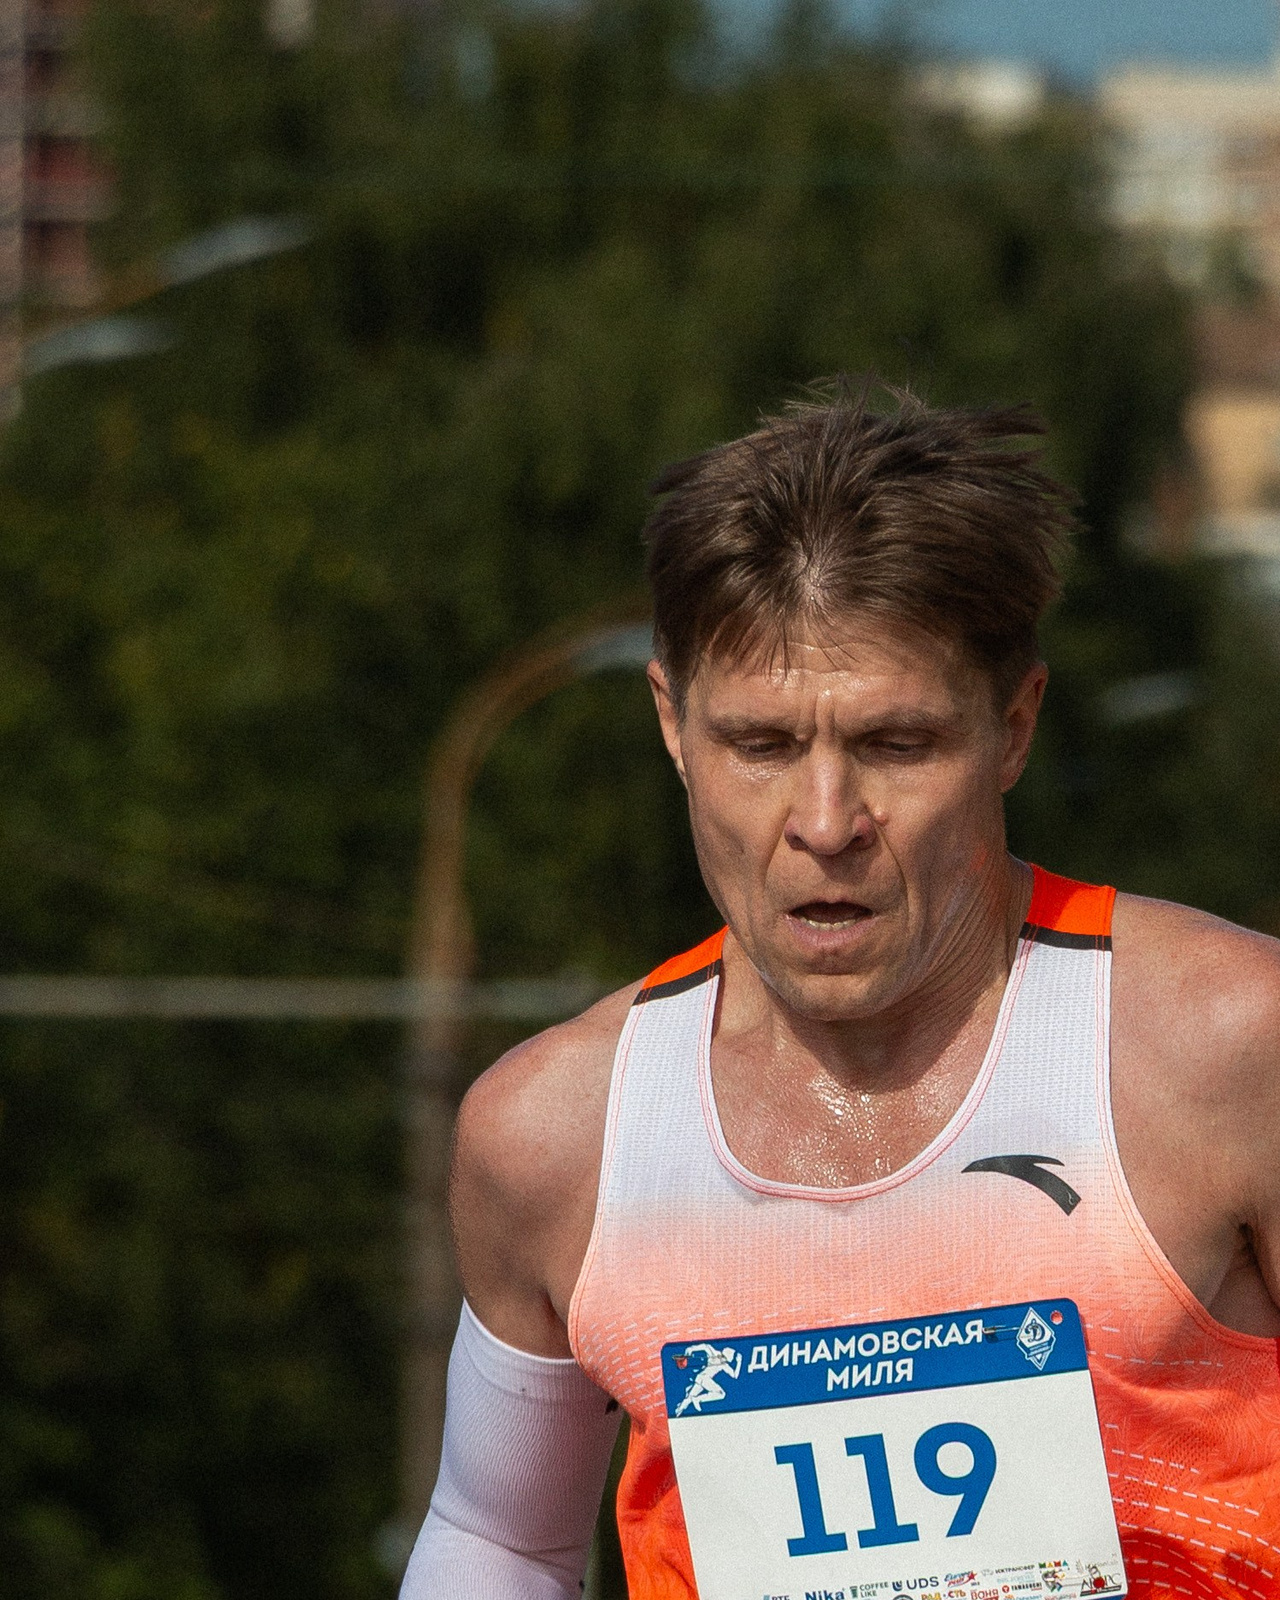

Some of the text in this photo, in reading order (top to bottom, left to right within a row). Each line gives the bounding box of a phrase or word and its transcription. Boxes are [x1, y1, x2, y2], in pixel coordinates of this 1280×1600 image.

[747, 1319, 984, 1373] ДИНАМОВСКАЯ
[826, 1356, 914, 1392] МИЛЯ
[774, 1421, 998, 1557] 119
[860, 1581, 889, 1591] COFFEE
[860, 1590, 877, 1598] LIKE
[906, 1576, 939, 1590] UDS
